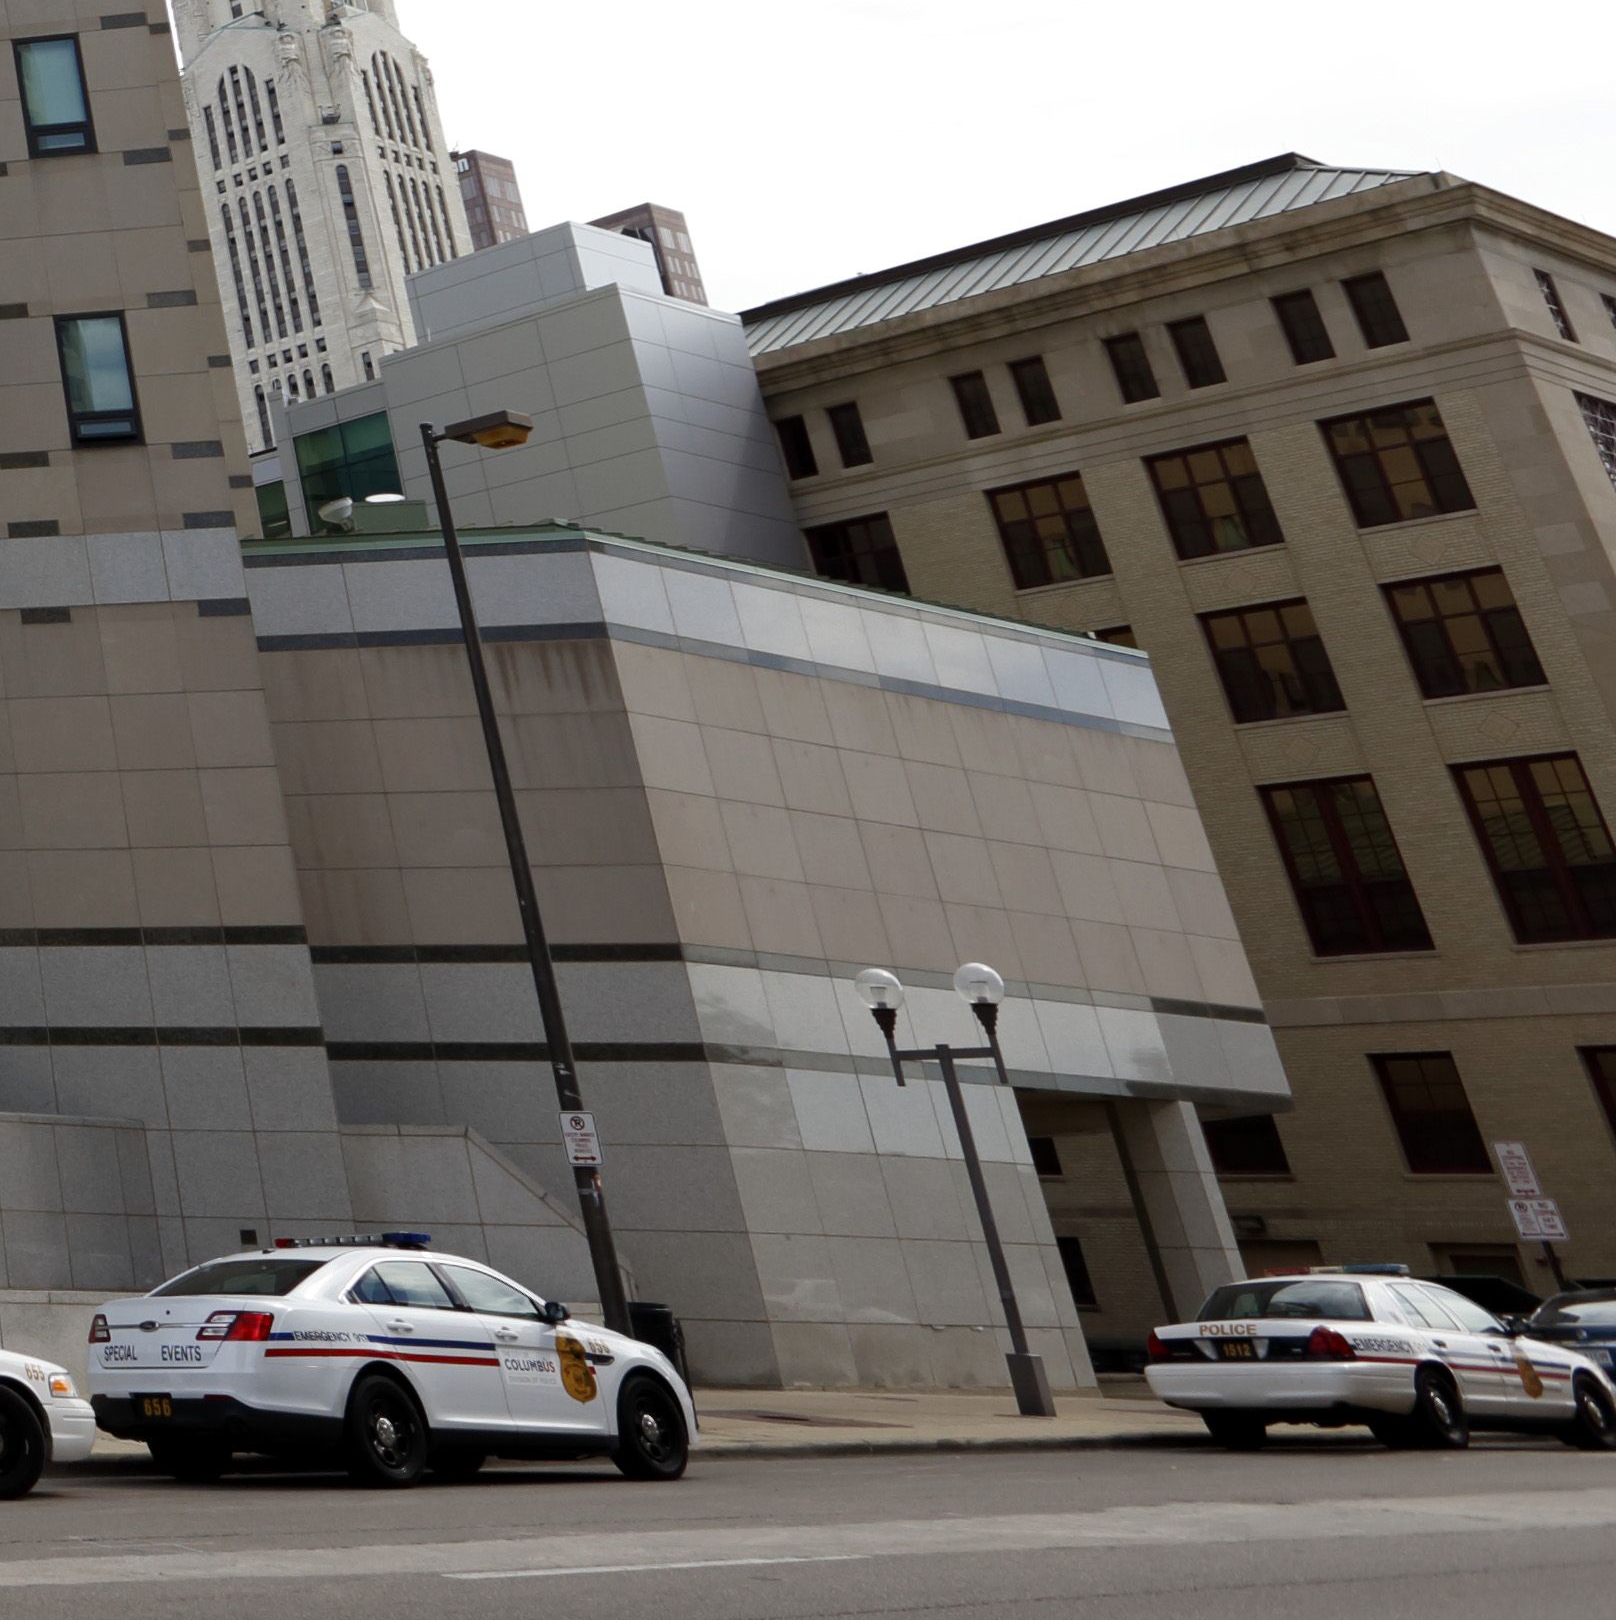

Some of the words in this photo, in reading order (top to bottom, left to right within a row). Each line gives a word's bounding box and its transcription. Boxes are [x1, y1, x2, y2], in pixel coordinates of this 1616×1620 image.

[293, 1330, 354, 1344] EMERGENCY
[1199, 1324, 1257, 1336] POLICE
[103, 1344, 138, 1362] SPECIAL
[161, 1345, 202, 1363] EVENTS
[1222, 1343, 1252, 1357] 1512
[1354, 1338, 1413, 1354] EMERGENCY
[504, 1357, 556, 1373] COLUMBUS
[143, 1396, 172, 1418] 656
